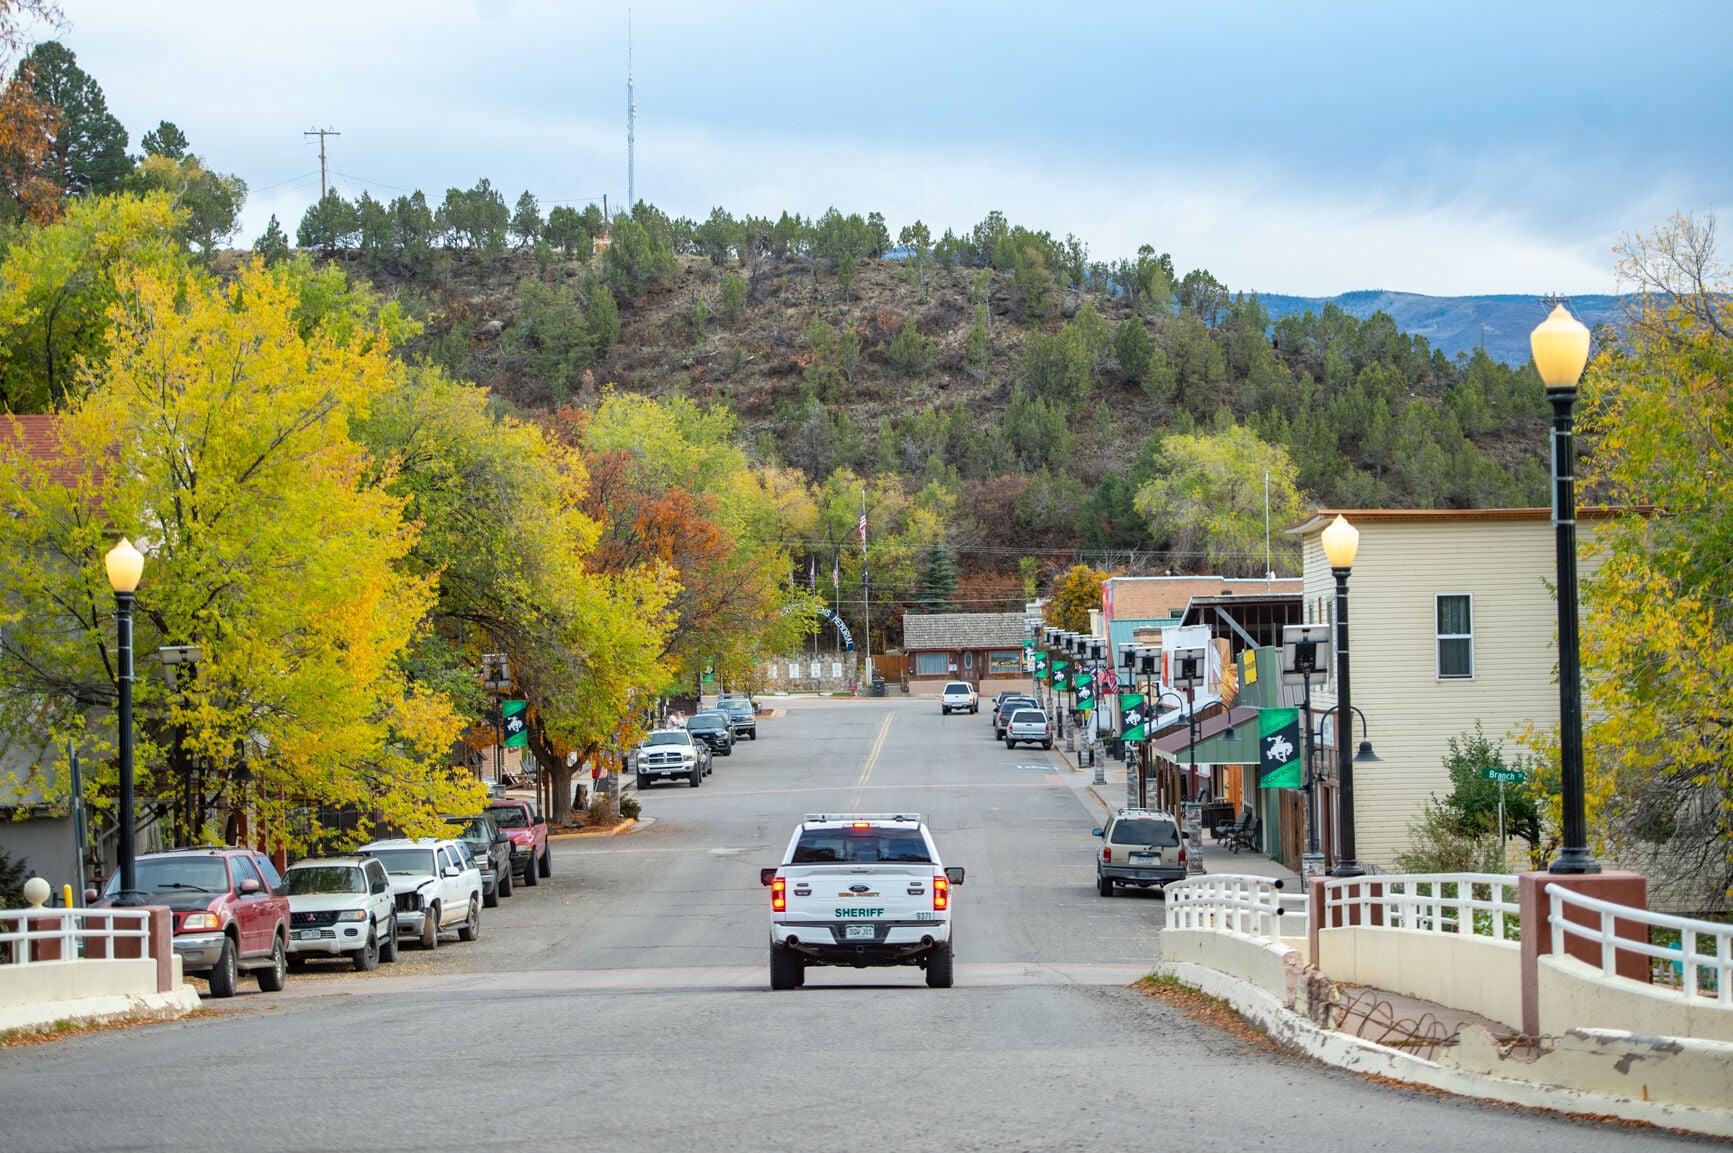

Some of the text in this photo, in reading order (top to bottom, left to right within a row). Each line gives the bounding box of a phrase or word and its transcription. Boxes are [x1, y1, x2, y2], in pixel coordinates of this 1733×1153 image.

[832, 615, 854, 648] MEMORIAL
[1489, 770, 1515, 780] Branch
[835, 908, 885, 918] SHERIFF
[916, 912, 931, 920] 9371
